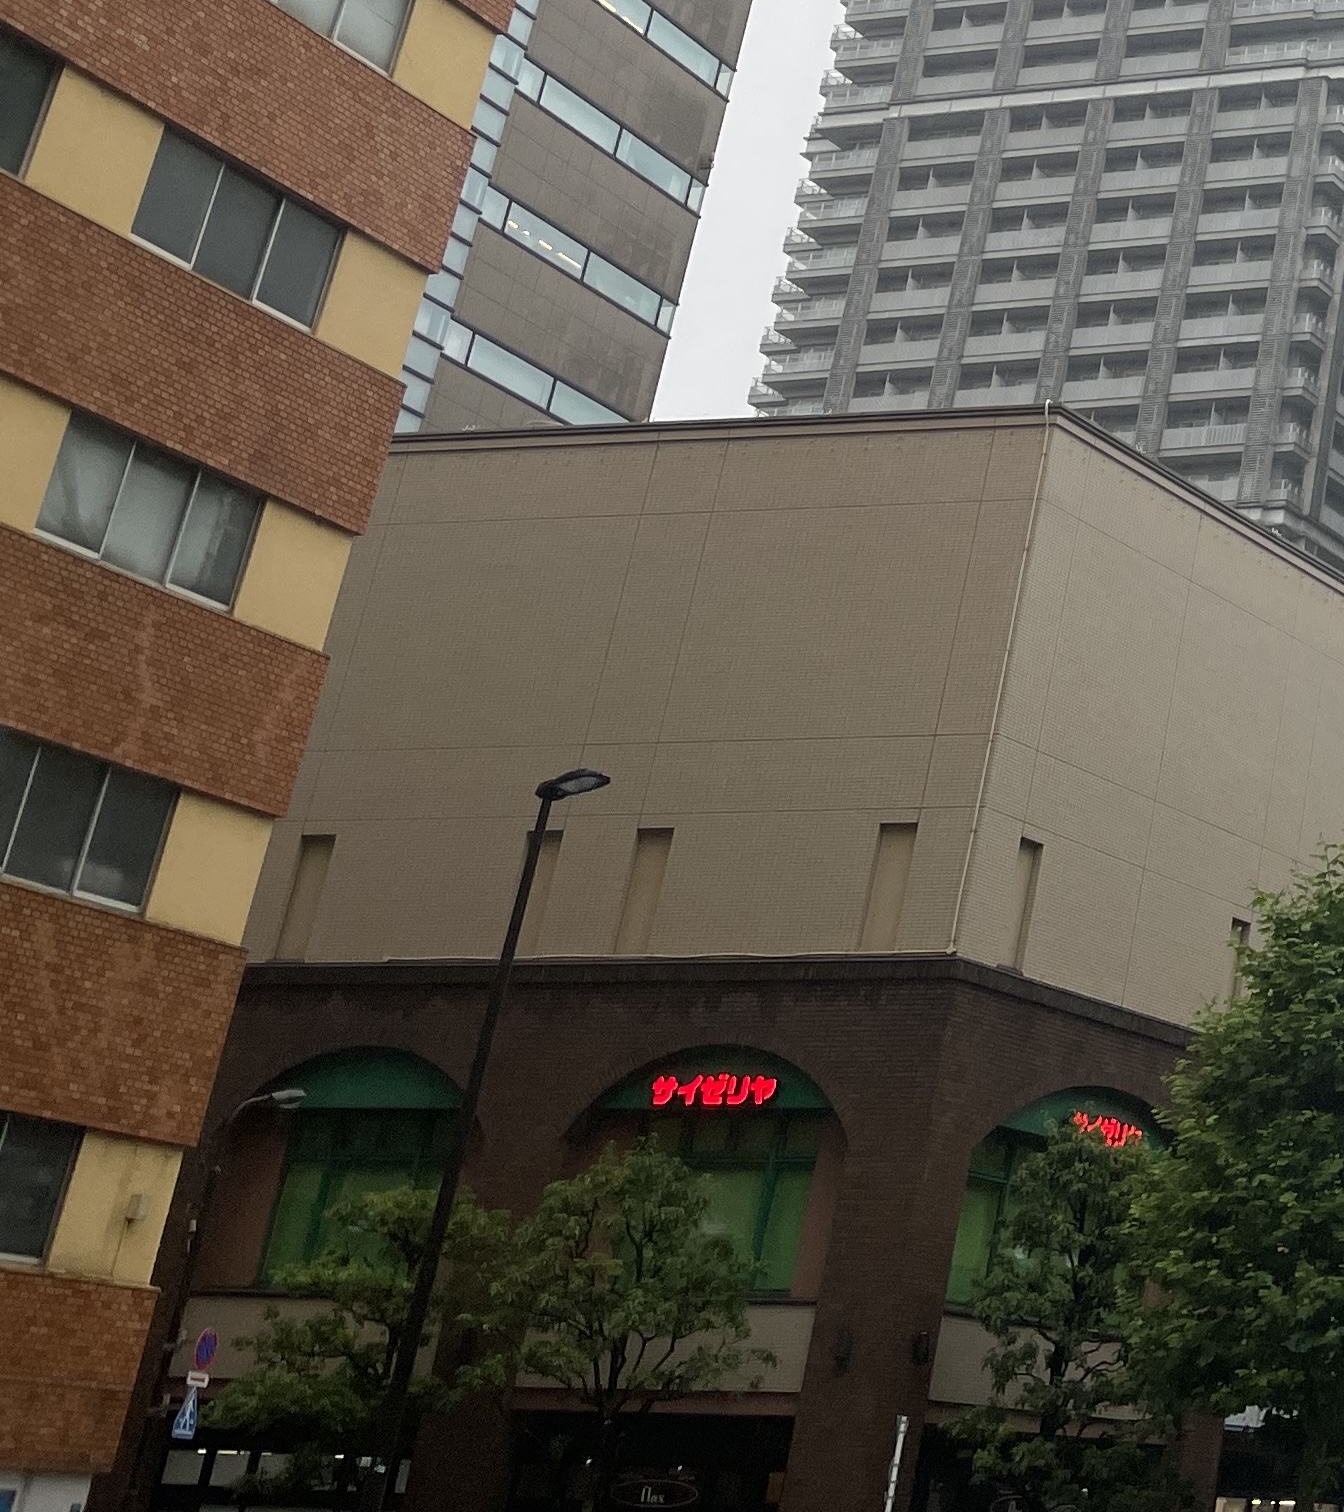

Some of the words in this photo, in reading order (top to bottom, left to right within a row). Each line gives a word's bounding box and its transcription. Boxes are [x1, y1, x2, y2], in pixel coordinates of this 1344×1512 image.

[652, 1073, 777, 1106] サイゼリヤ
